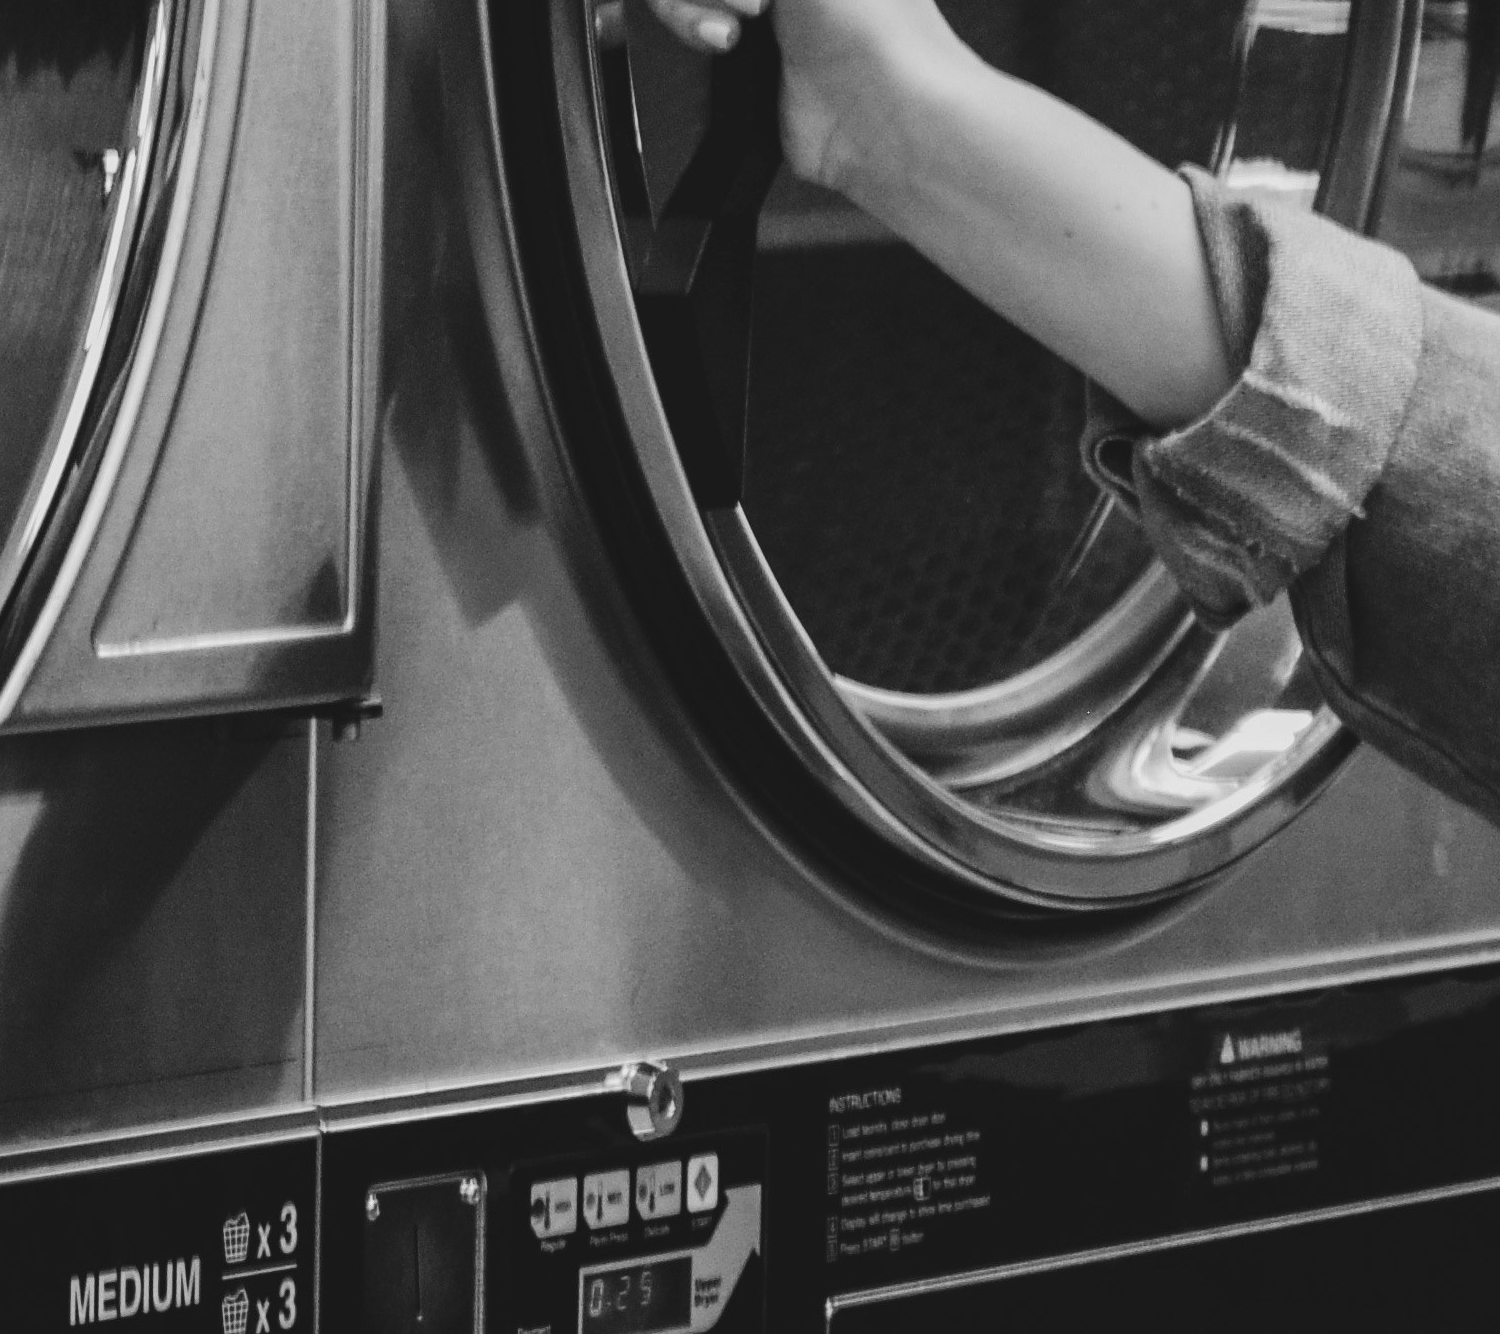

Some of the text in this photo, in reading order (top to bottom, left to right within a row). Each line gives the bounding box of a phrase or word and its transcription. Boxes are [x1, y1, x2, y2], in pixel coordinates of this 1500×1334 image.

[257, 1200, 297, 1259] x 3
[70, 1255, 201, 1327] MEDIUM
[256, 1277, 296, 1334] x 3
